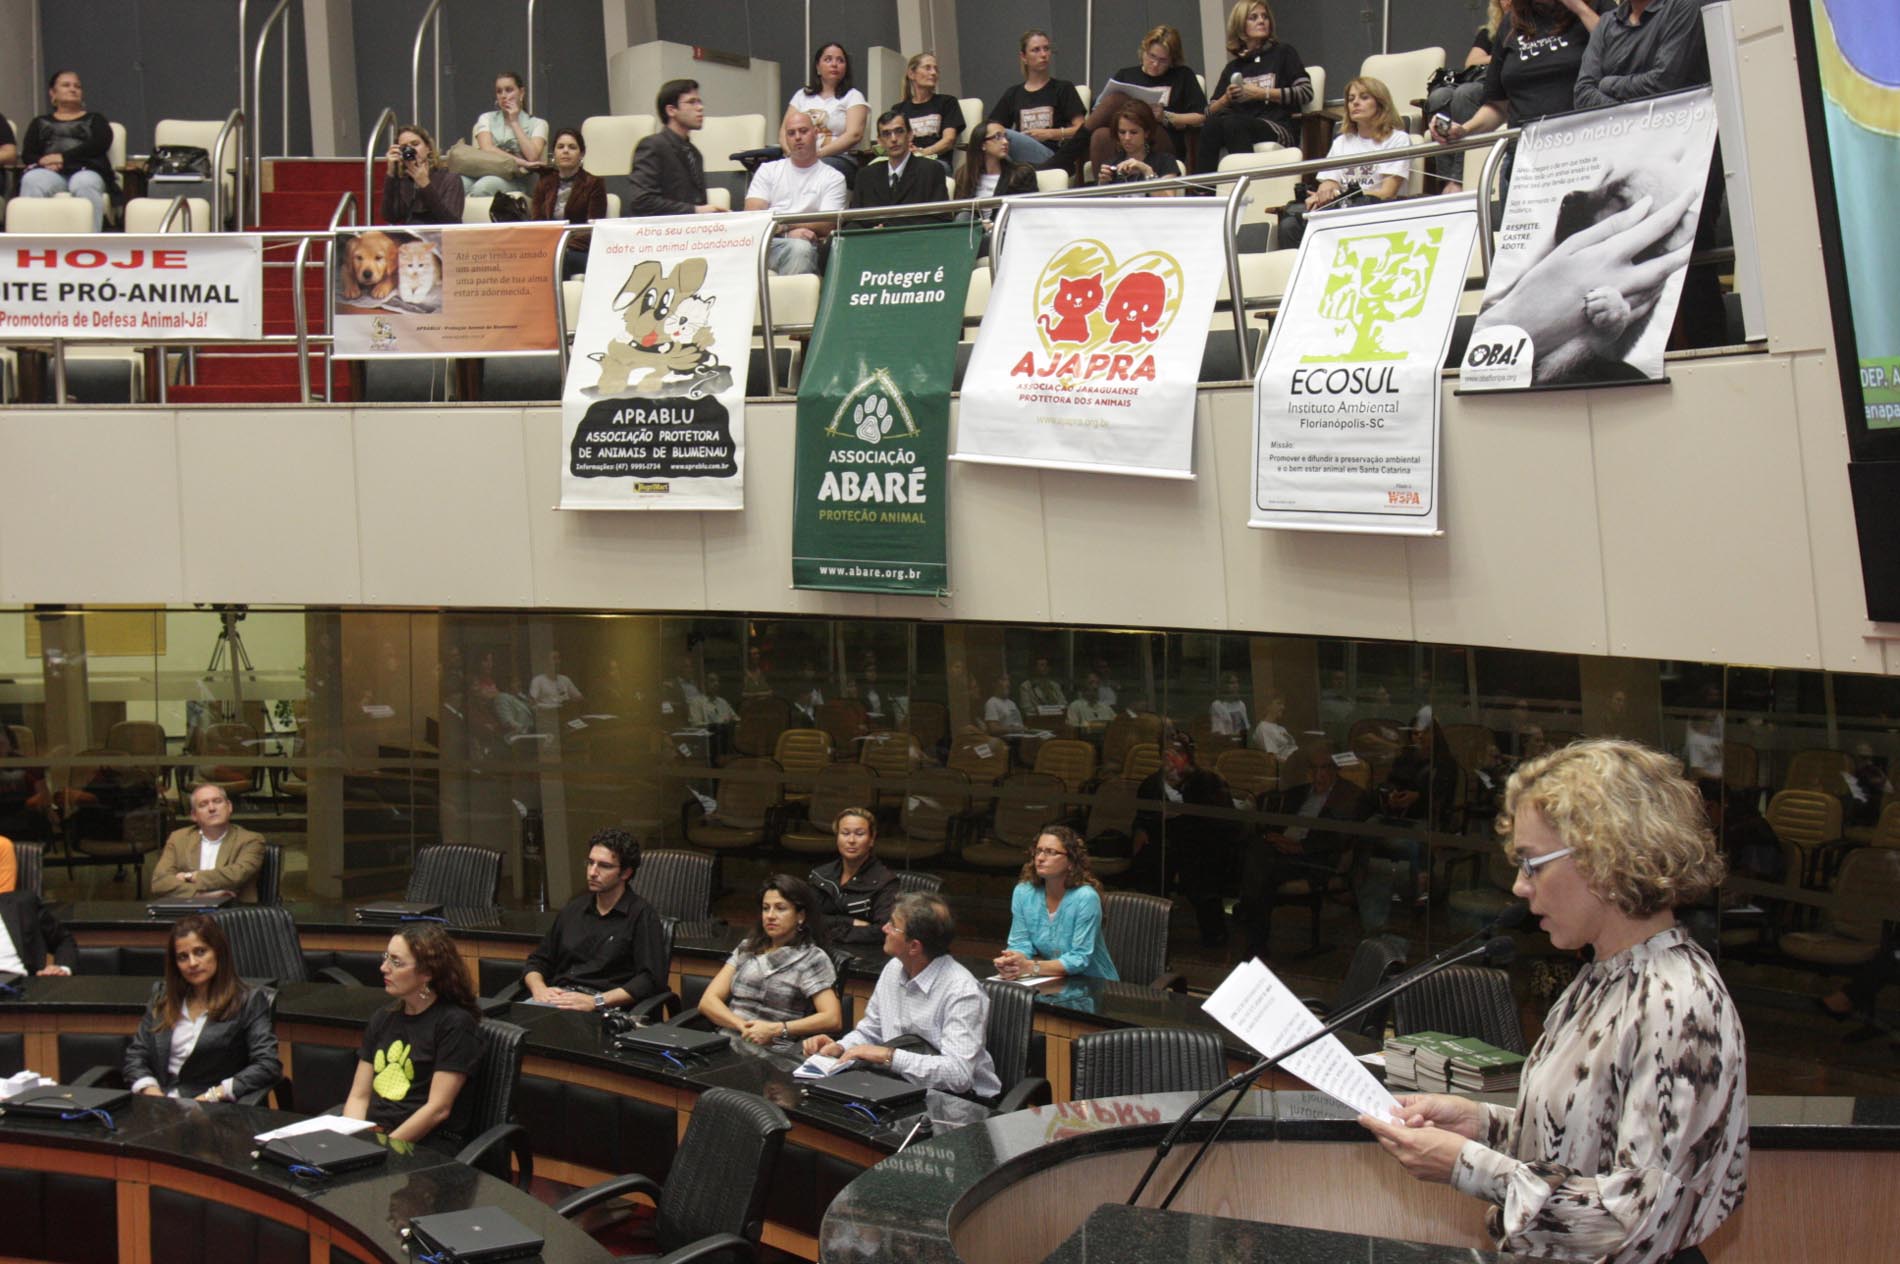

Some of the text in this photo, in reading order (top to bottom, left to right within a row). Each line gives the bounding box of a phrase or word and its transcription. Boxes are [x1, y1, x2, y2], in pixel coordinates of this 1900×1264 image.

[1520, 127, 1574, 150] Nosso
[1580, 117, 1633, 142] maior
[636, 223, 728, 237] Abra seu coração,
[606, 237, 755, 254] adote um animal abandonado!
[17, 249, 188, 269] HOJE
[472, 252, 485, 262] que
[860, 266, 944, 288] Proteger é
[0, 278, 239, 303] ITE PRÓ-ANIMAL
[850, 289, 945, 306] ser humano
[0, 311, 208, 328] Promotoria de Defesa Animal-Já!
[1467, 338, 1527, 367] OBA!
[1010, 351, 1156, 382] AJAPRA
[1290, 366, 1399, 395] ECOSUL
[1860, 368, 1888, 387] DEP.
[1017, 383, 1140, 396] ASSOCIAÇÃO JARAGUAENSE
[1018, 394, 1132, 407] PROTETORA DOS ANIMAIS
[1288, 400, 1399, 414] Instituto Ambiental
[612, 408, 695, 424] APRABLU
[1300, 418, 1385, 430] Florianópolis-SC
[585, 428, 720, 444] ASSOCIAÇÃO PROTETORA
[578, 446, 728, 458] DE ANIMAIS DE BLUMENAU
[829, 448, 916, 466] ASSOCIAÇÃO
[1269, 454, 1300, 463] Promover
[1307, 454, 1333, 463] difundir
[1340, 455, 1384, 465] preservação
[1385, 455, 1421, 464] ambiental
[615, 463, 628, 472] (47)
[1323, 465, 1345, 473] animal
[1359, 465, 1380, 474] Santa
[1381, 466, 1411, 474] Catarina
[817, 466, 927, 504] ABARÉ
[1388, 491, 1421, 504] WSPA
[819, 508, 926, 524] PROTEÇÃO ANIMAL
[819, 565, 921, 580] www.abare.org.br
